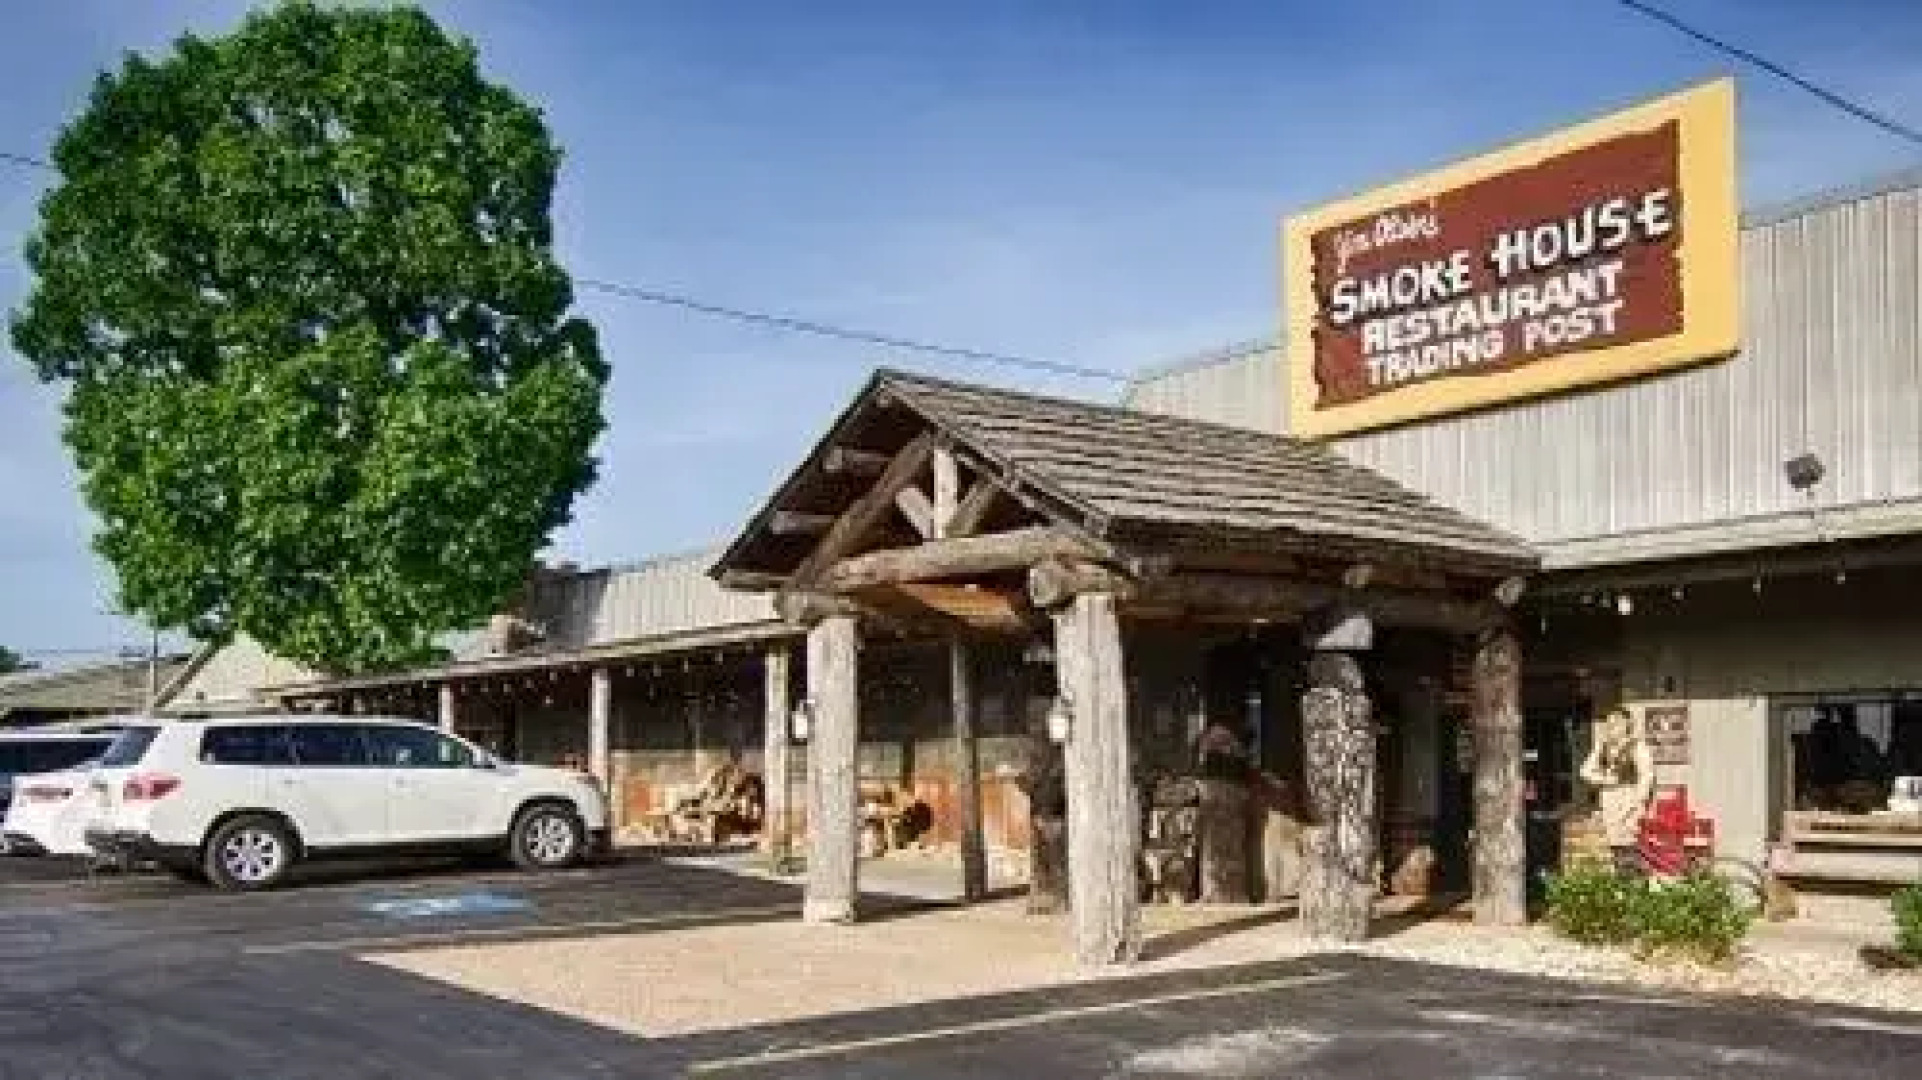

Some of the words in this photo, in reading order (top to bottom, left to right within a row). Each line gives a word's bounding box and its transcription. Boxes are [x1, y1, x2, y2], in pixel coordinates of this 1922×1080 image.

[1331, 250, 1472, 324] SMOKE
[1491, 188, 1671, 278] HOUSE
[1361, 261, 1625, 355] RESTAURANT
[1367, 332, 1504, 385] TRADING
[1522, 300, 1624, 351] POST
